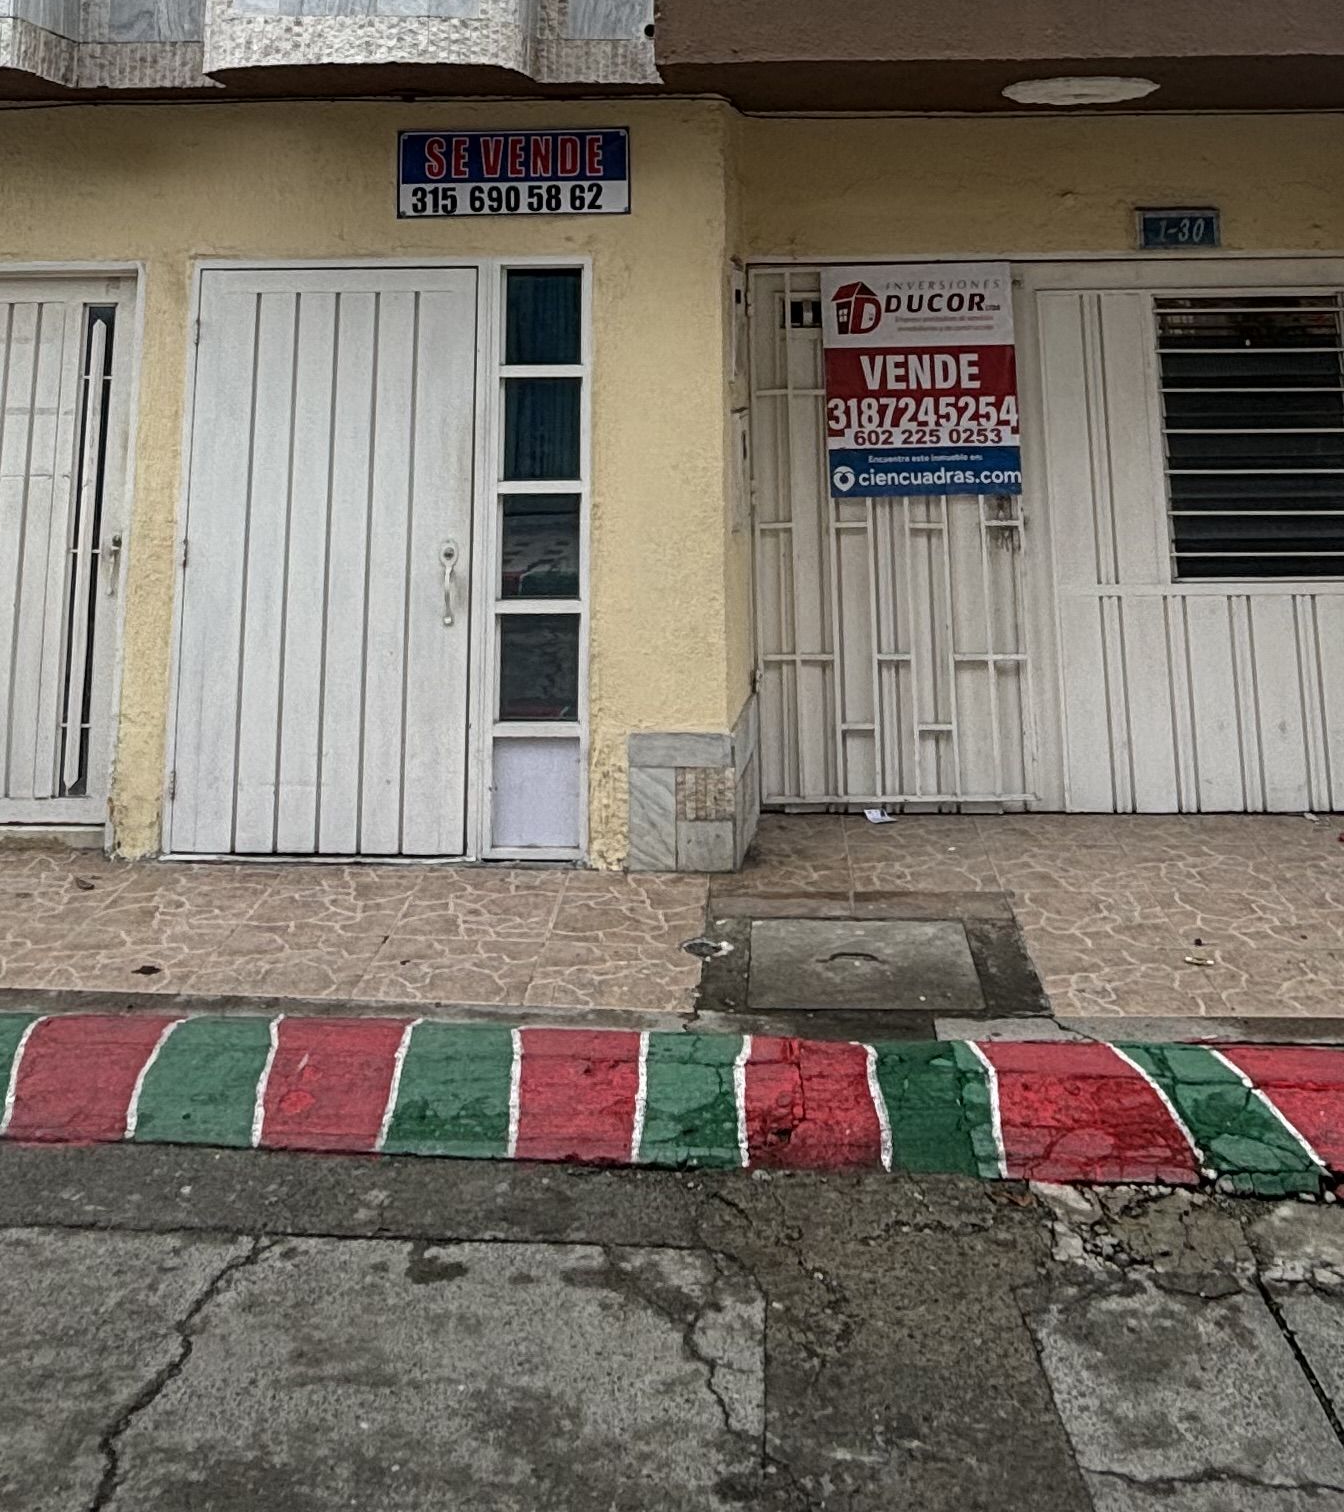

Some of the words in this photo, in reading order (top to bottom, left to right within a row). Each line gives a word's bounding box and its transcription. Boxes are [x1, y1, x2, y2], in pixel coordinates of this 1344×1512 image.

[424, 136, 469, 179] SE
[480, 135, 603, 178] VENDE
[411, 186, 457, 214] 315
[469, 185, 520, 213] 690
[527, 184, 562, 211] 58
[569, 182, 603, 211] 62
[885, 278, 1001, 291] INVERSIONES
[884, 292, 986, 313] DUCOR
[859, 353, 981, 390] VENDE
[827, 395, 1019, 430] 3187245254
[854, 430, 894, 446] 602
[901, 429, 941, 445] 225
[949, 427, 1003, 444] 0253
[858, 466, 1022, 487] ciencuadras.com
